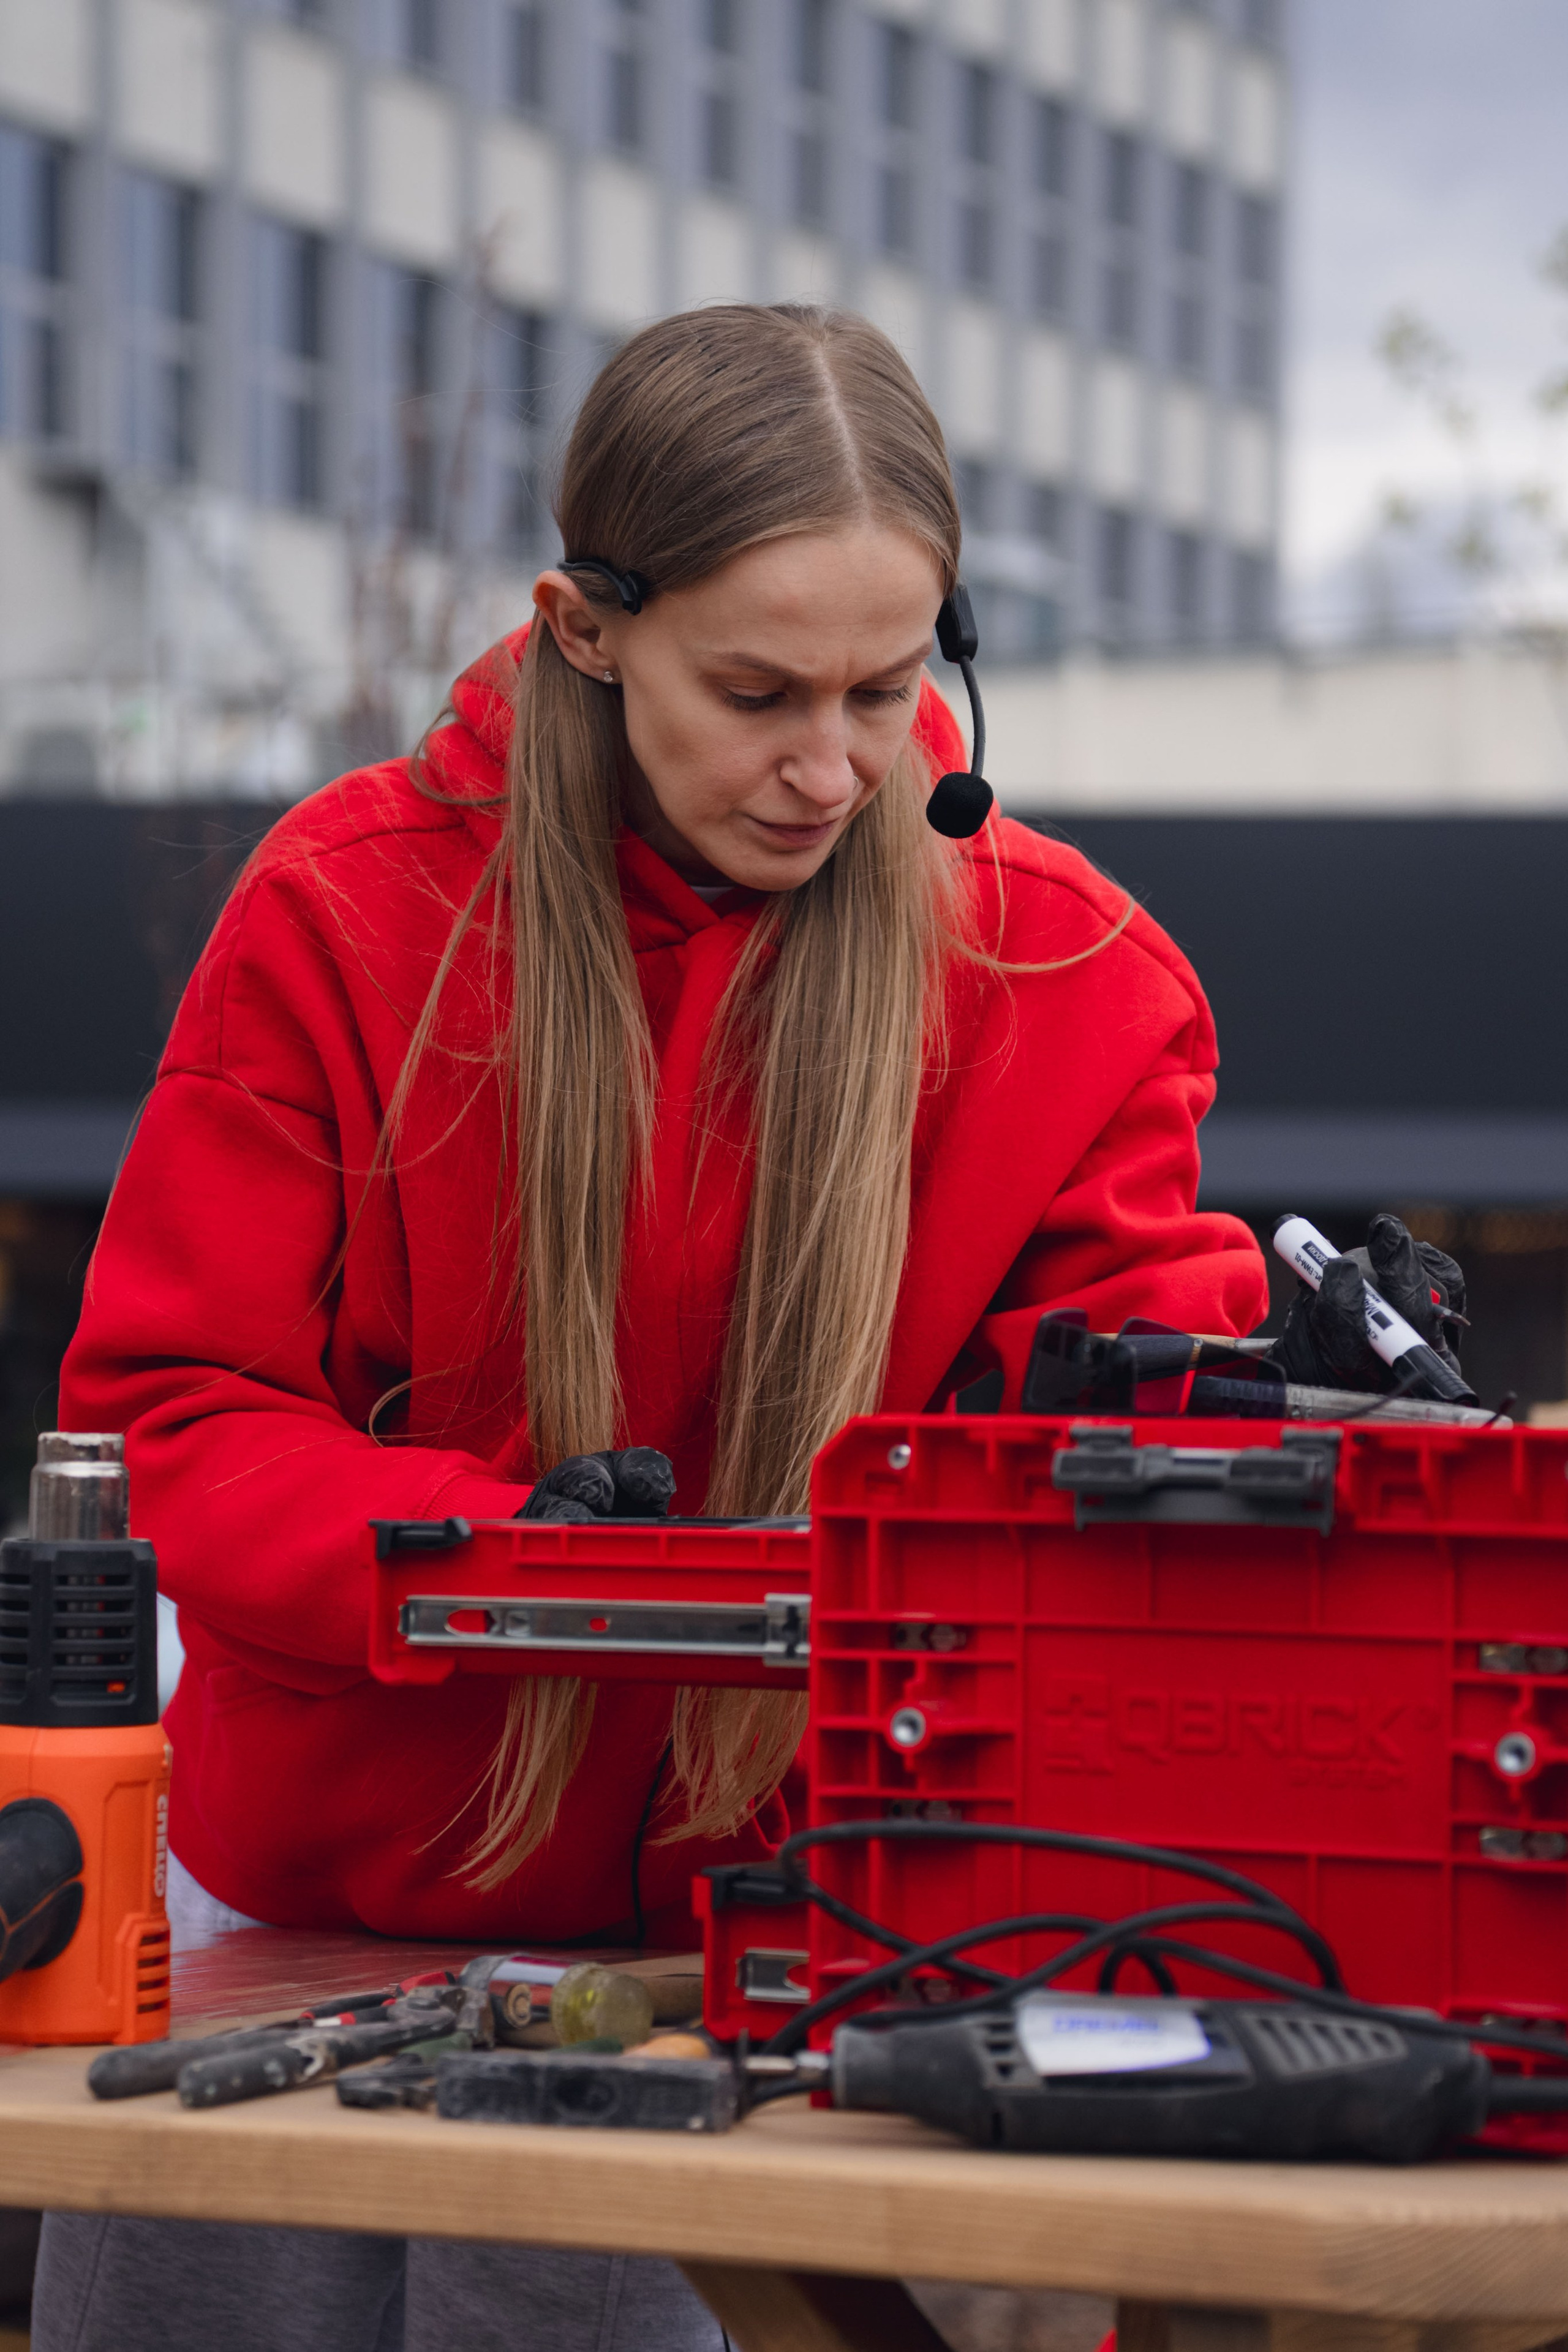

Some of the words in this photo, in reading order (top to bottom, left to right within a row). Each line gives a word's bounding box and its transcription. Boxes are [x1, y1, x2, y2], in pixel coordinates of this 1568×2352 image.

[1295, 1253, 1314, 1275] EWM-01
[1307, 1245, 1329, 1262] ДОСКИ
[1116, 1688, 1408, 1765] QBRICK
